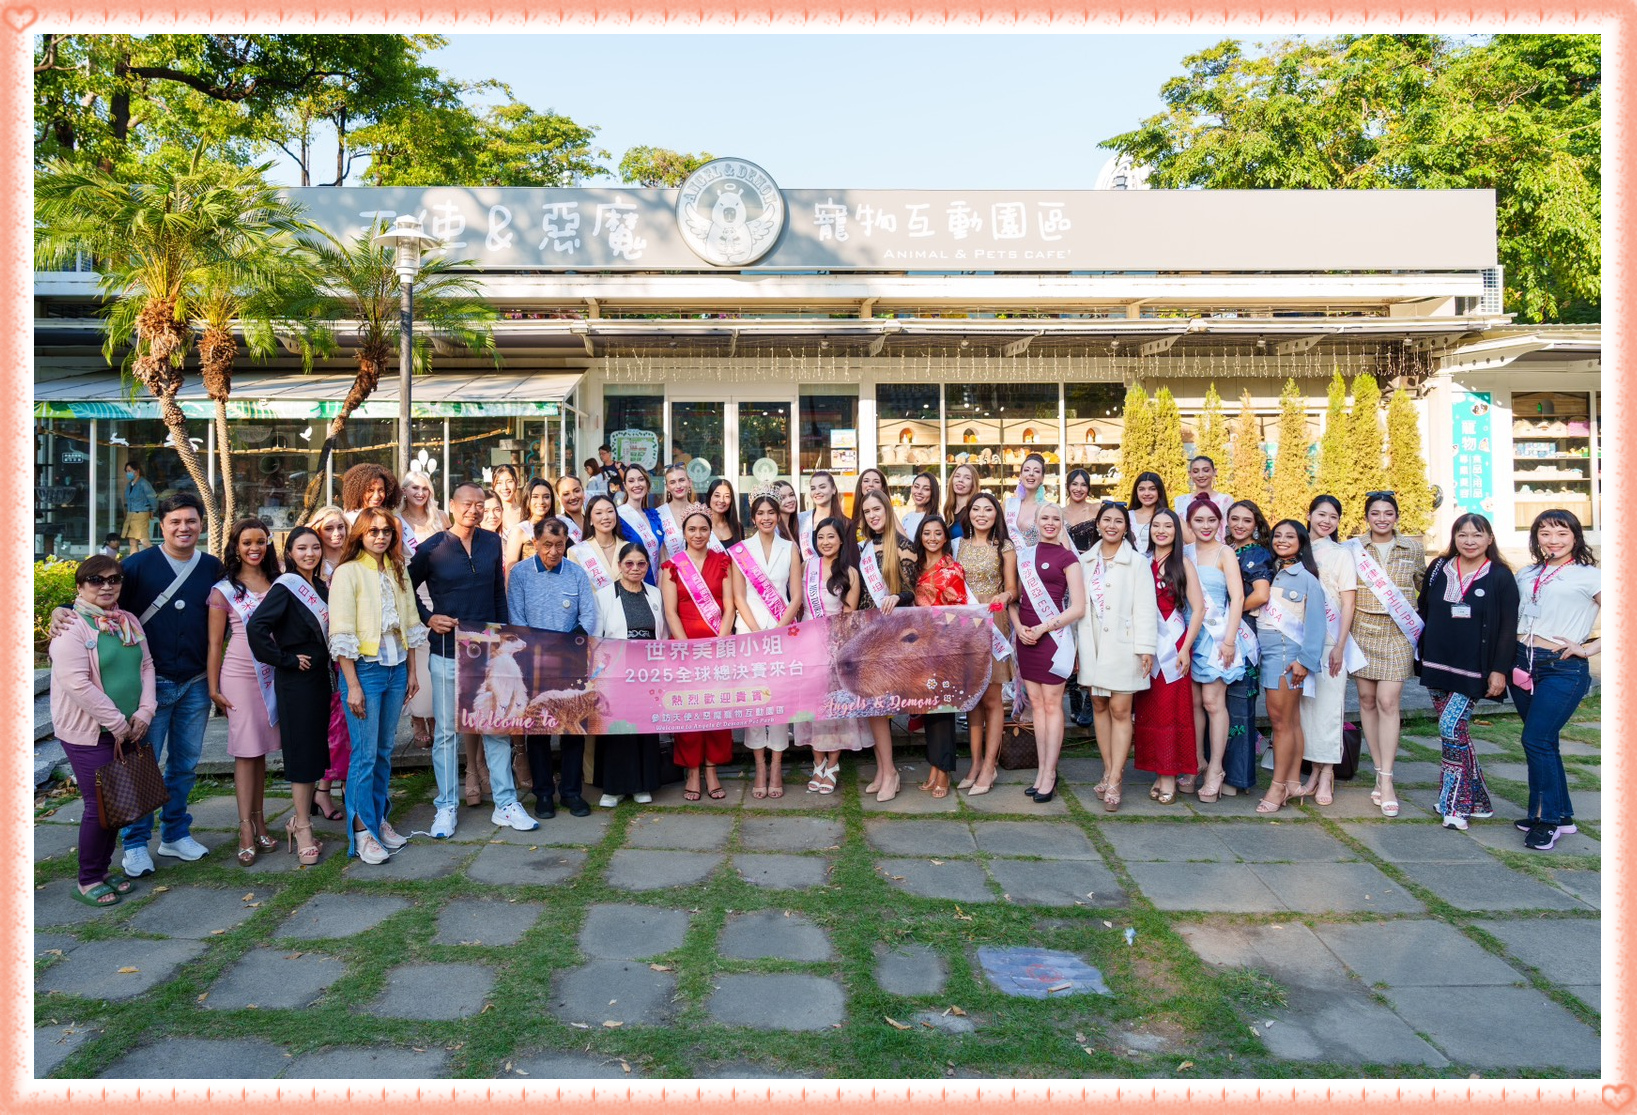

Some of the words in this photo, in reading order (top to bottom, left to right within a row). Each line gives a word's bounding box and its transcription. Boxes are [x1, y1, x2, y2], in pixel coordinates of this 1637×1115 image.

[684, 164, 722, 203] ANGEL
[724, 163, 735, 177] &
[813, 197, 1072, 242] 寵物互動園區
[955, 249, 966, 259] &
[298, 585, 319, 606] 日本
[645, 634, 783, 661] 世界美顏小姐
[625, 659, 804, 683] 2025全球總決賽來台
[671, 690, 762, 706] 熱烈歡迎貴賓
[822, 695, 867, 716] Angels
[873, 696, 885, 709] &
[890, 695, 939, 709] Demons
[461, 708, 535, 728] Welcome
[540, 707, 559, 728] to
